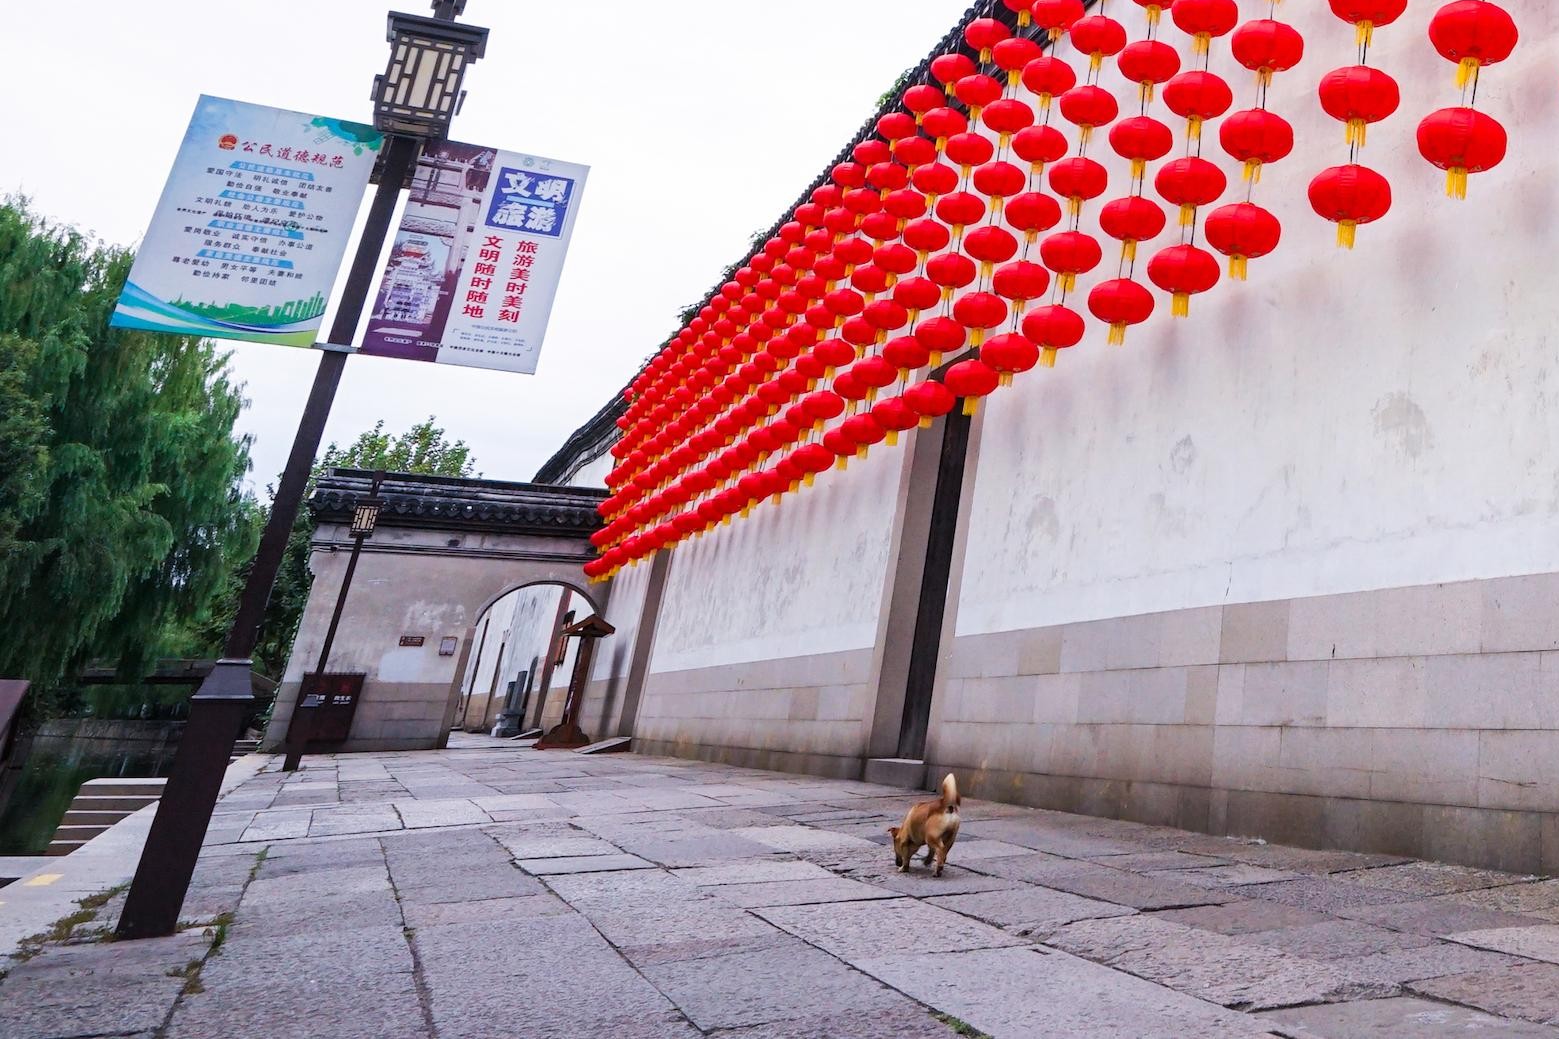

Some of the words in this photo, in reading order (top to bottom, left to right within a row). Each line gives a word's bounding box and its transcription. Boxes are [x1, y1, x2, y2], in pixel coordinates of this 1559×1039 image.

[241, 140, 344, 169] 公民道德规范
[501, 172, 568, 202] 文明
[491, 203, 558, 232] 旅游
[462, 235, 504, 319] 文明随时随地
[497, 239, 540, 323] 旅游美时美刻
